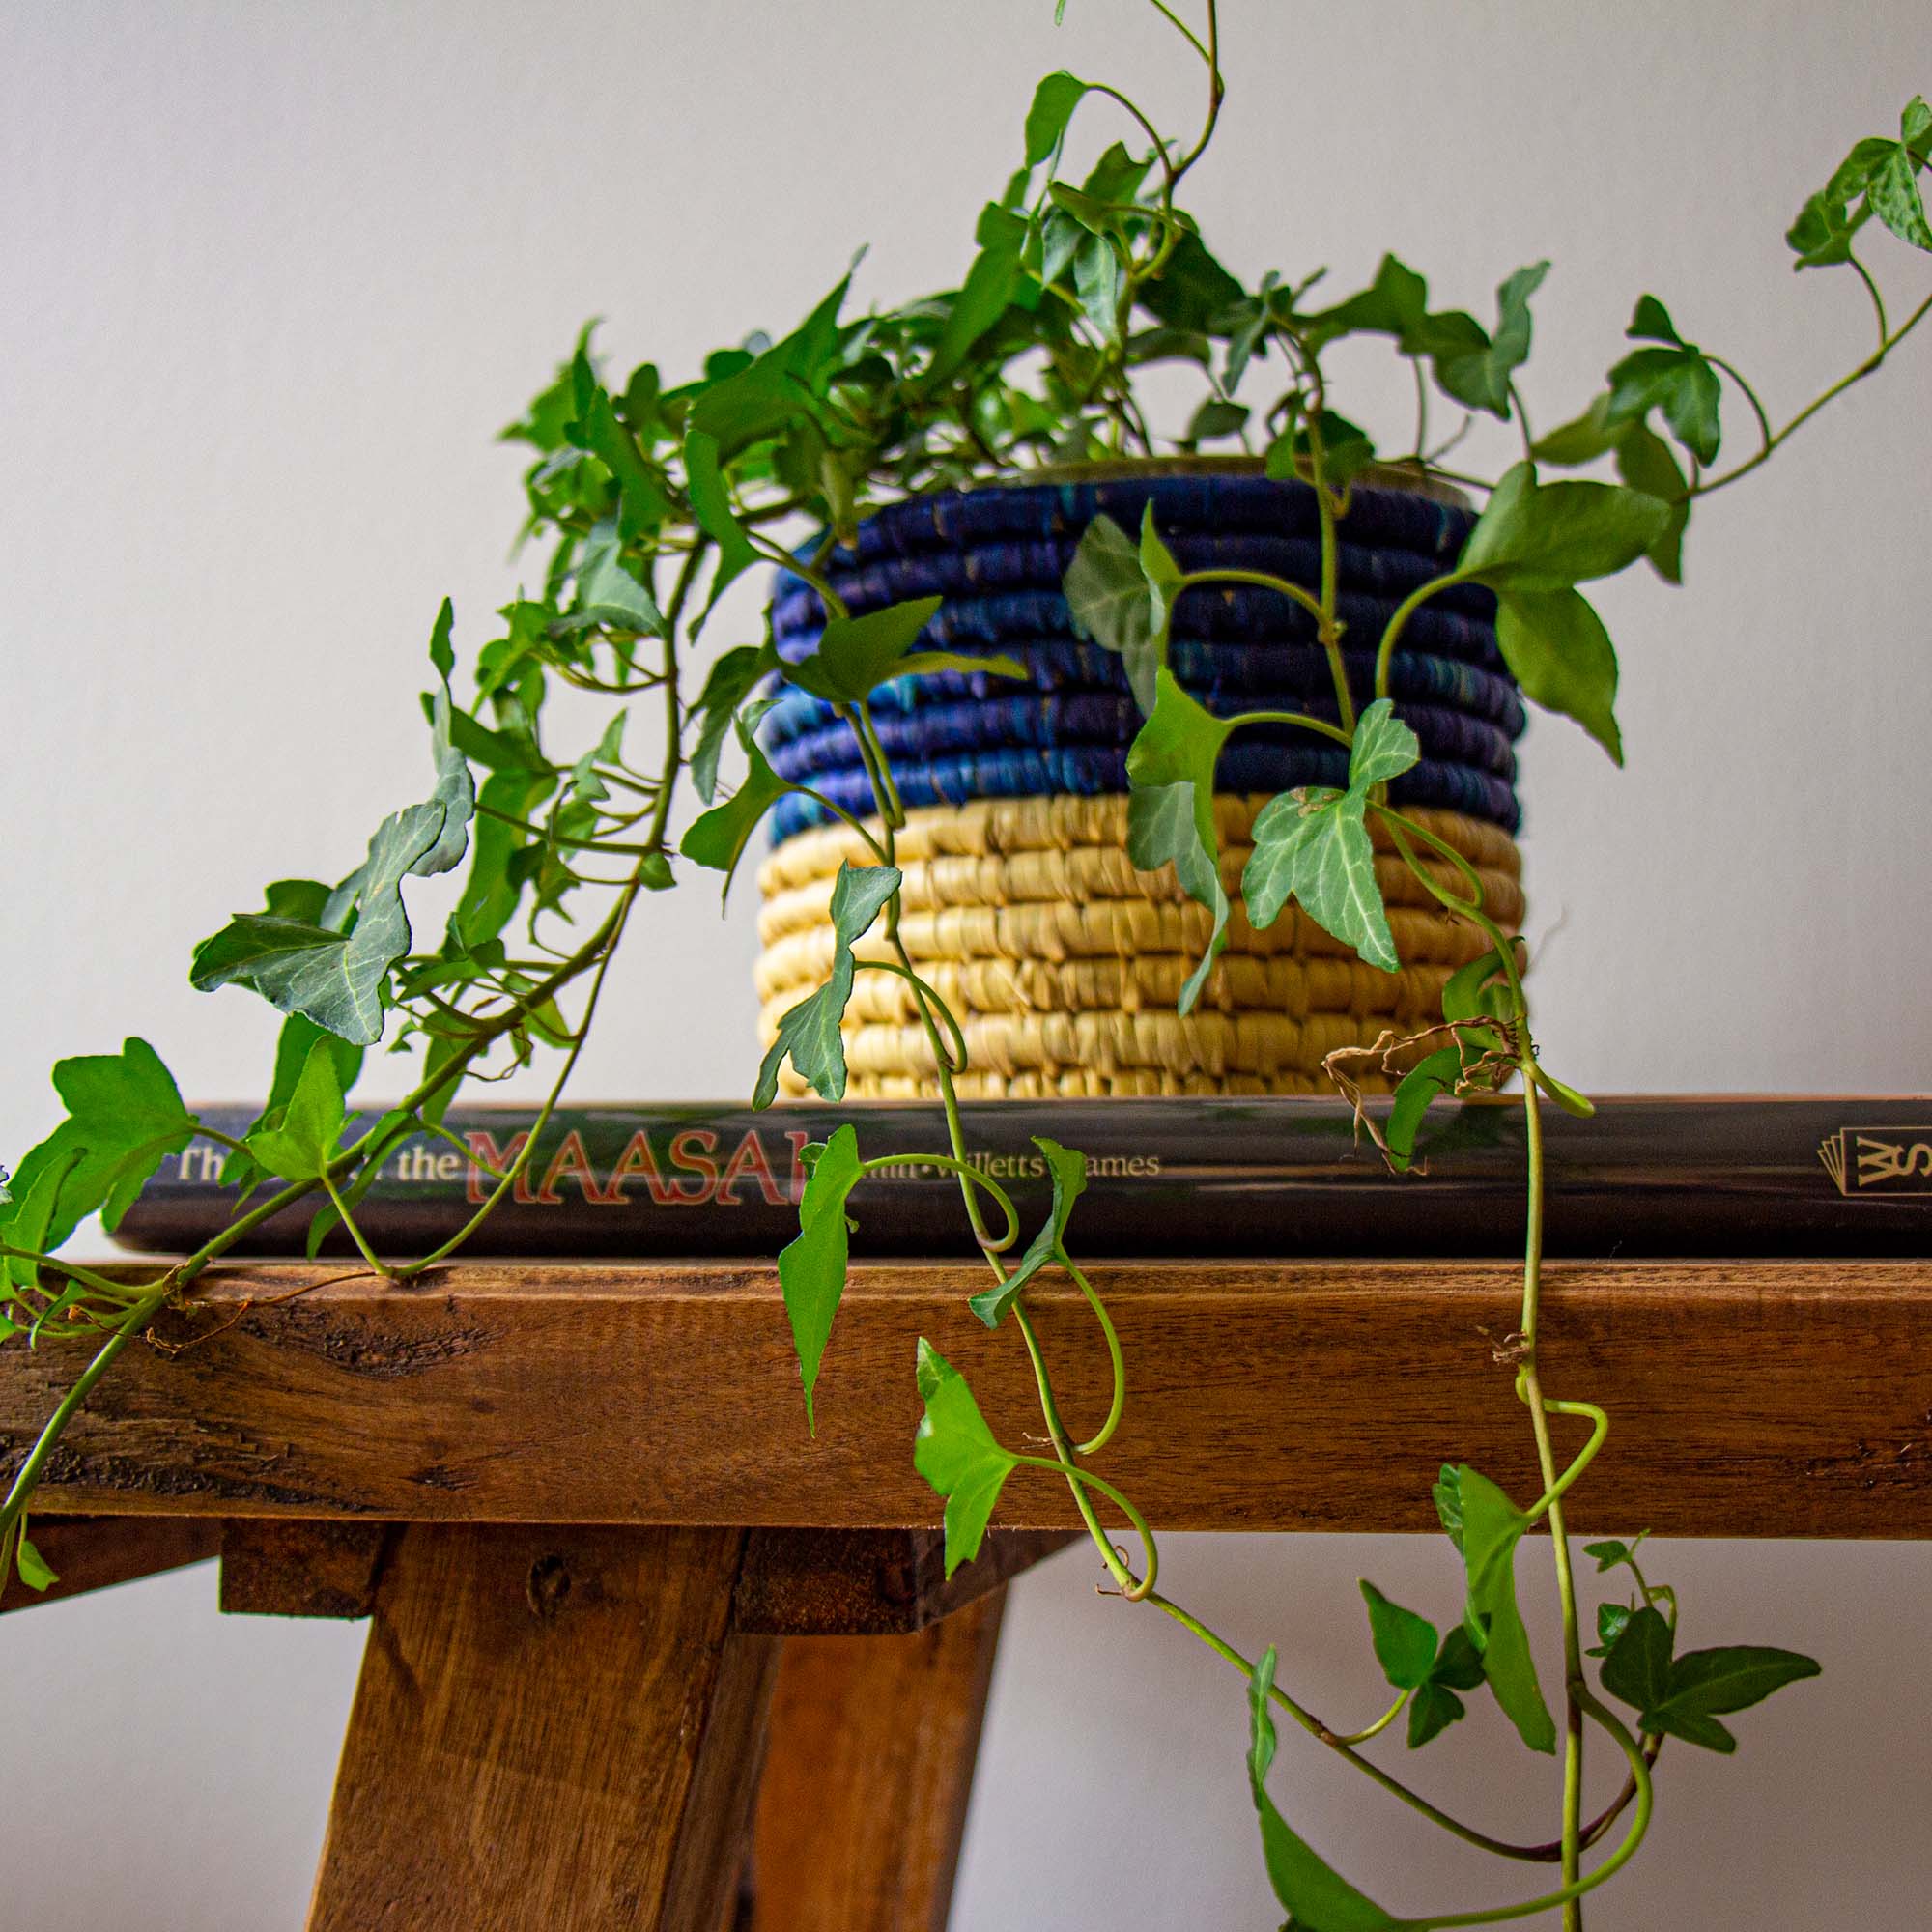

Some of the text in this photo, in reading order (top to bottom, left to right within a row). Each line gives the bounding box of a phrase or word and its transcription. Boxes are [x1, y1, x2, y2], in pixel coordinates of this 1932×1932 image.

[175, 1146, 229, 1181] Th
[397, 1144, 461, 1180] the
[463, 1129, 808, 1205] MAASAI
[1083, 1155, 1160, 1178] ames
